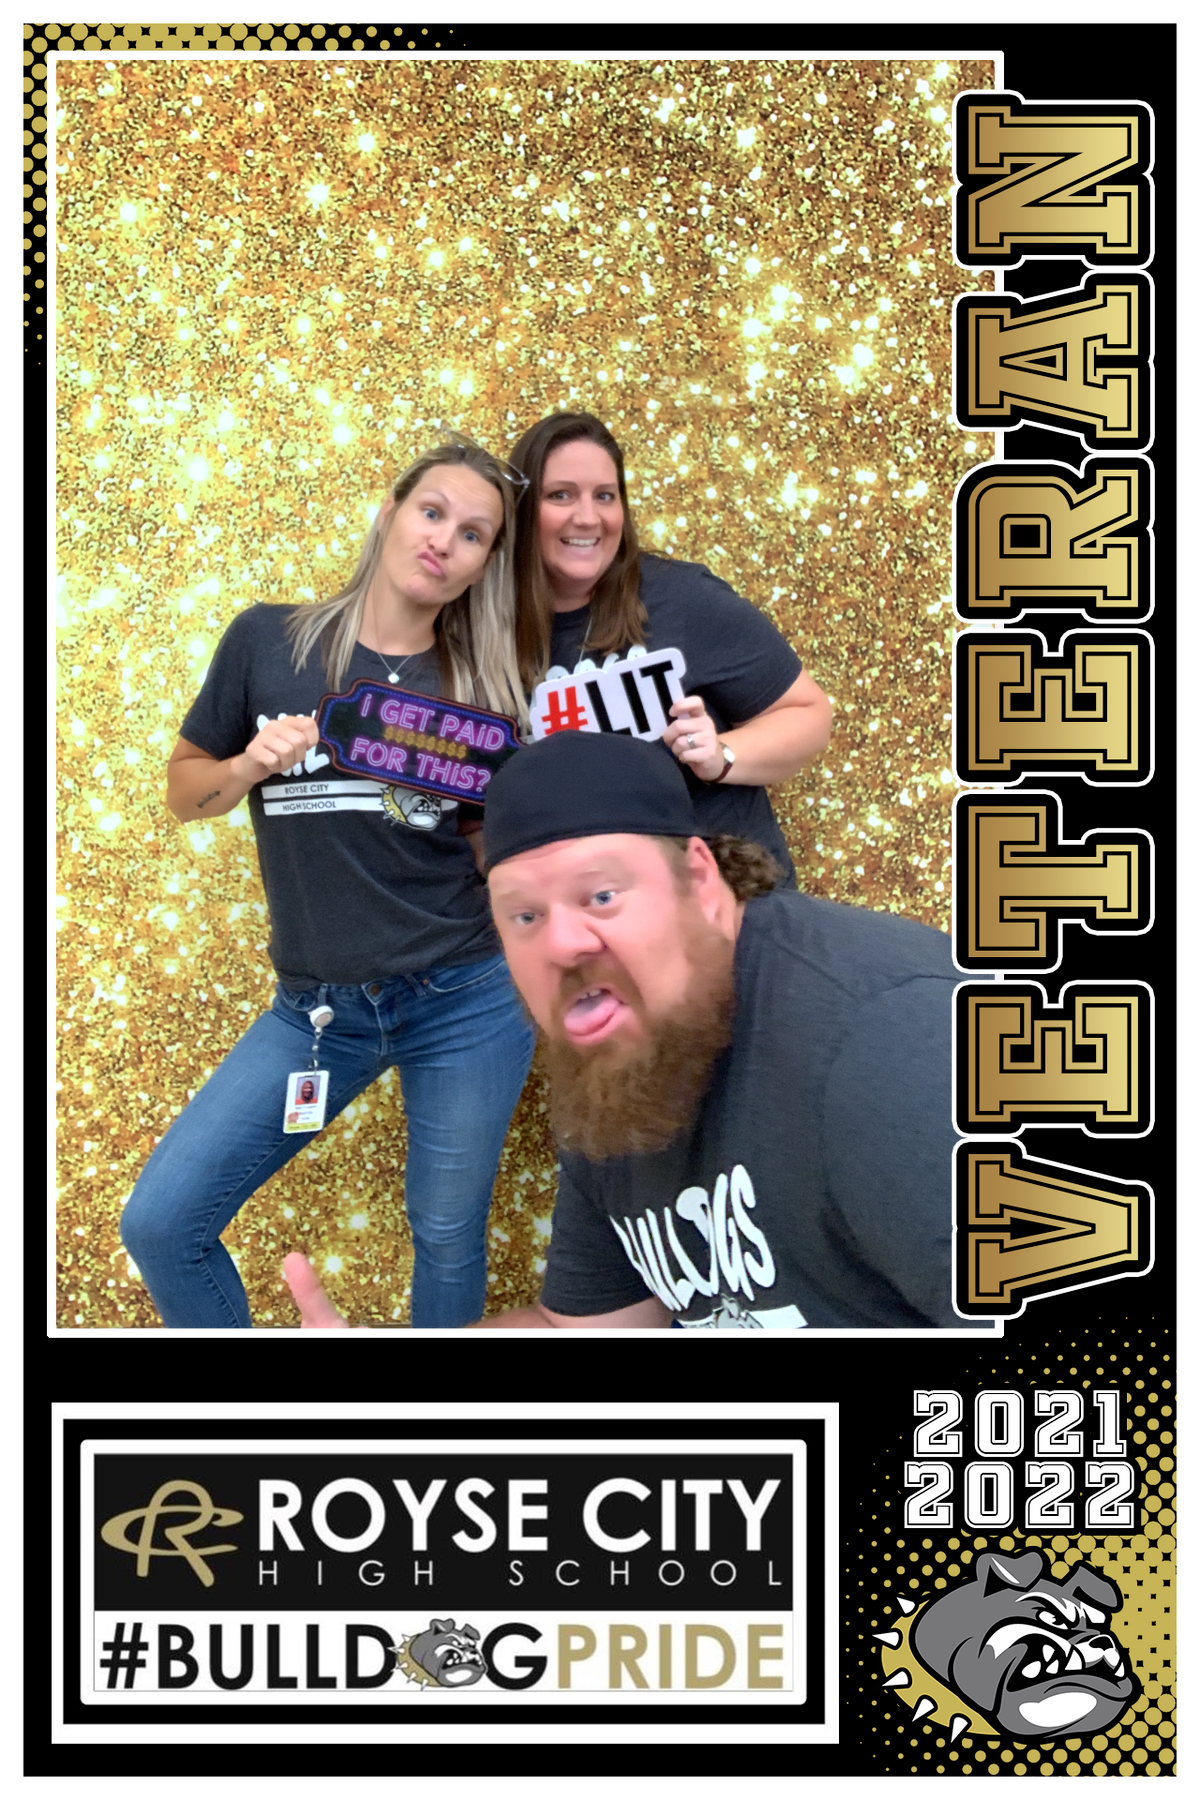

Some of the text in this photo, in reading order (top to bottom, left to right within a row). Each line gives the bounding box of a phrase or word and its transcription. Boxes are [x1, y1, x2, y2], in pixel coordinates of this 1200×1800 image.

[541, 660, 674, 737] #LIT
[380, 699, 435, 732] GET
[439, 714, 505, 751] PAID
[285, 784, 329, 795] ROYSE CITY
[350, 737, 407, 773] FOR
[416, 753, 492, 793] THIS?
[282, 800, 337, 812] HIGH SCHOOL
